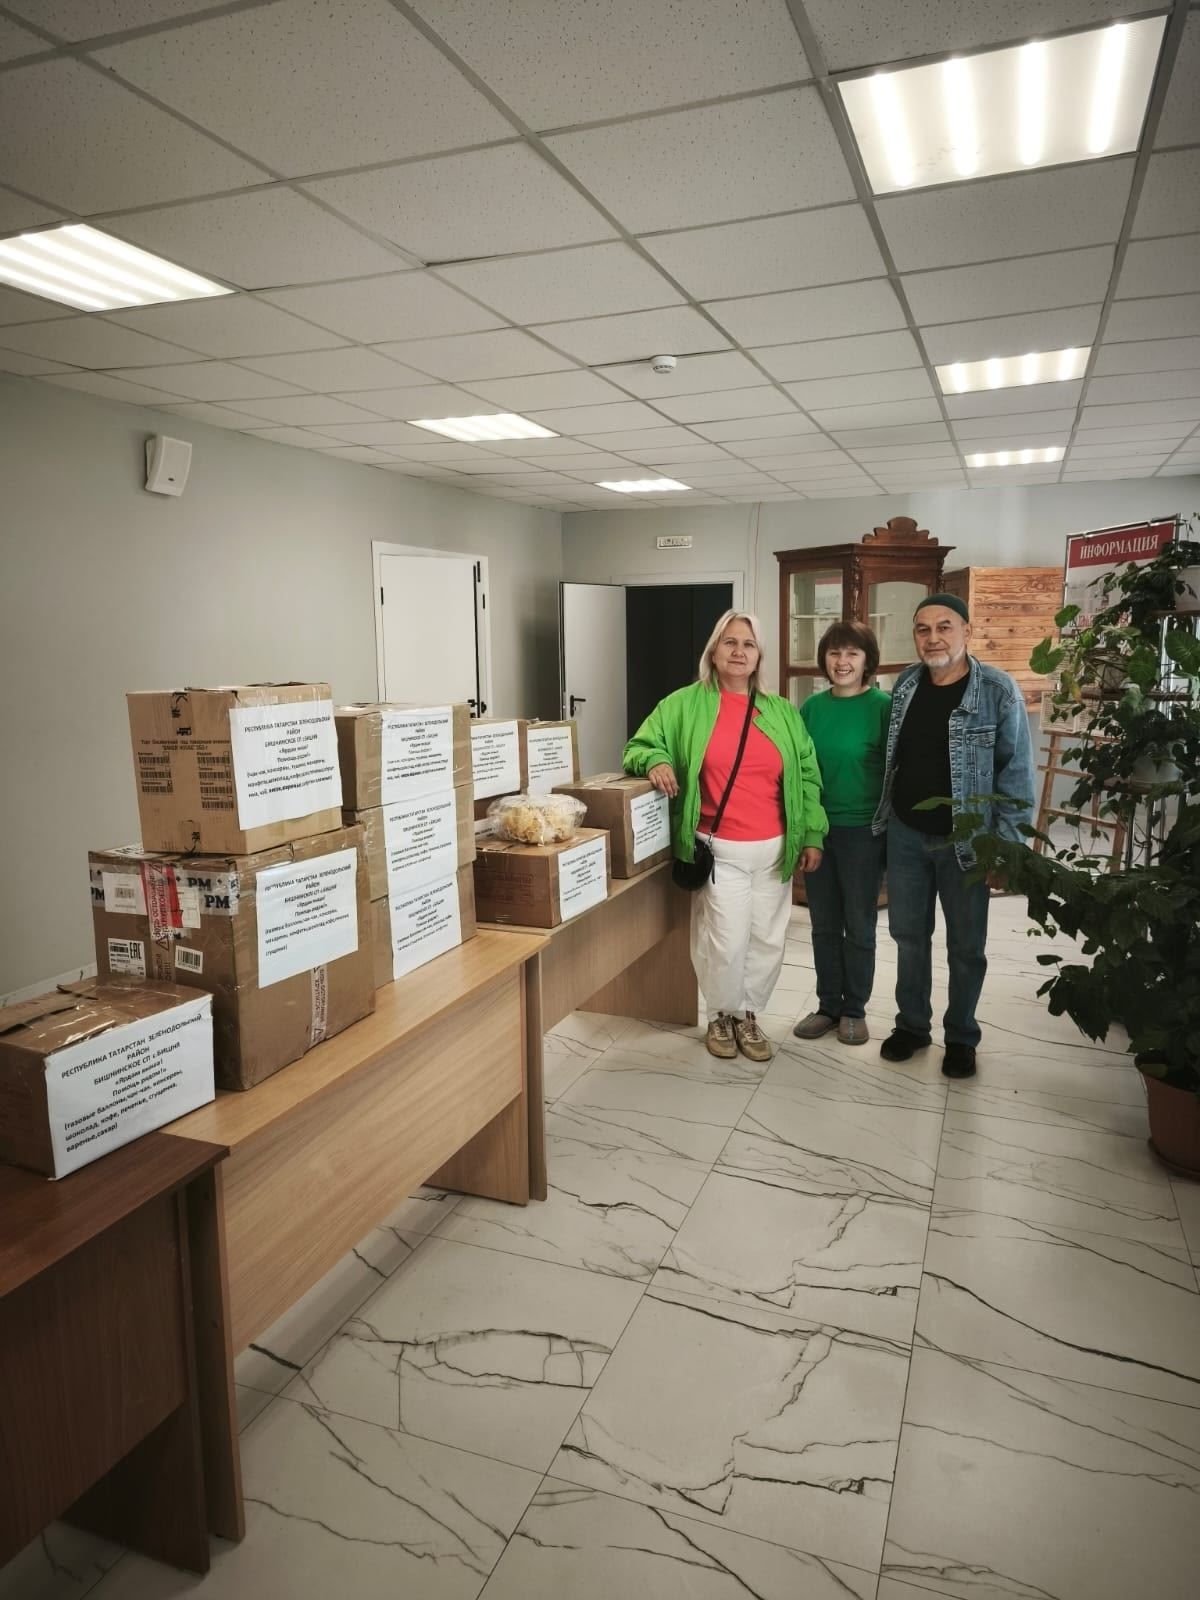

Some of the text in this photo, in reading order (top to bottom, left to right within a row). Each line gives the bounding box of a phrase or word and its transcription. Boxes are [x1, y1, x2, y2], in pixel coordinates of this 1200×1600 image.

[1080, 535, 1159, 559] ИНФОРМАЦИЯ
[306, 882, 320, 890] РАЙОН
[204, 895, 230, 908] PM
[61, 1014, 202, 1078] РЕСПУБЛИКА ТАТАРСТАН ЗЕЛЕНОДОЛЬСКИЙ
[127, 1046, 150, 1060] РАЙОН
[94, 1060, 140, 1085] БИШНИНСКОЕ
[142, 1055, 150, 1064] СП
[112, 1081, 140, 1096] Помощь
[65, 1111, 96, 1130] (газовые
[100, 1112, 120, 1124] кофе,
